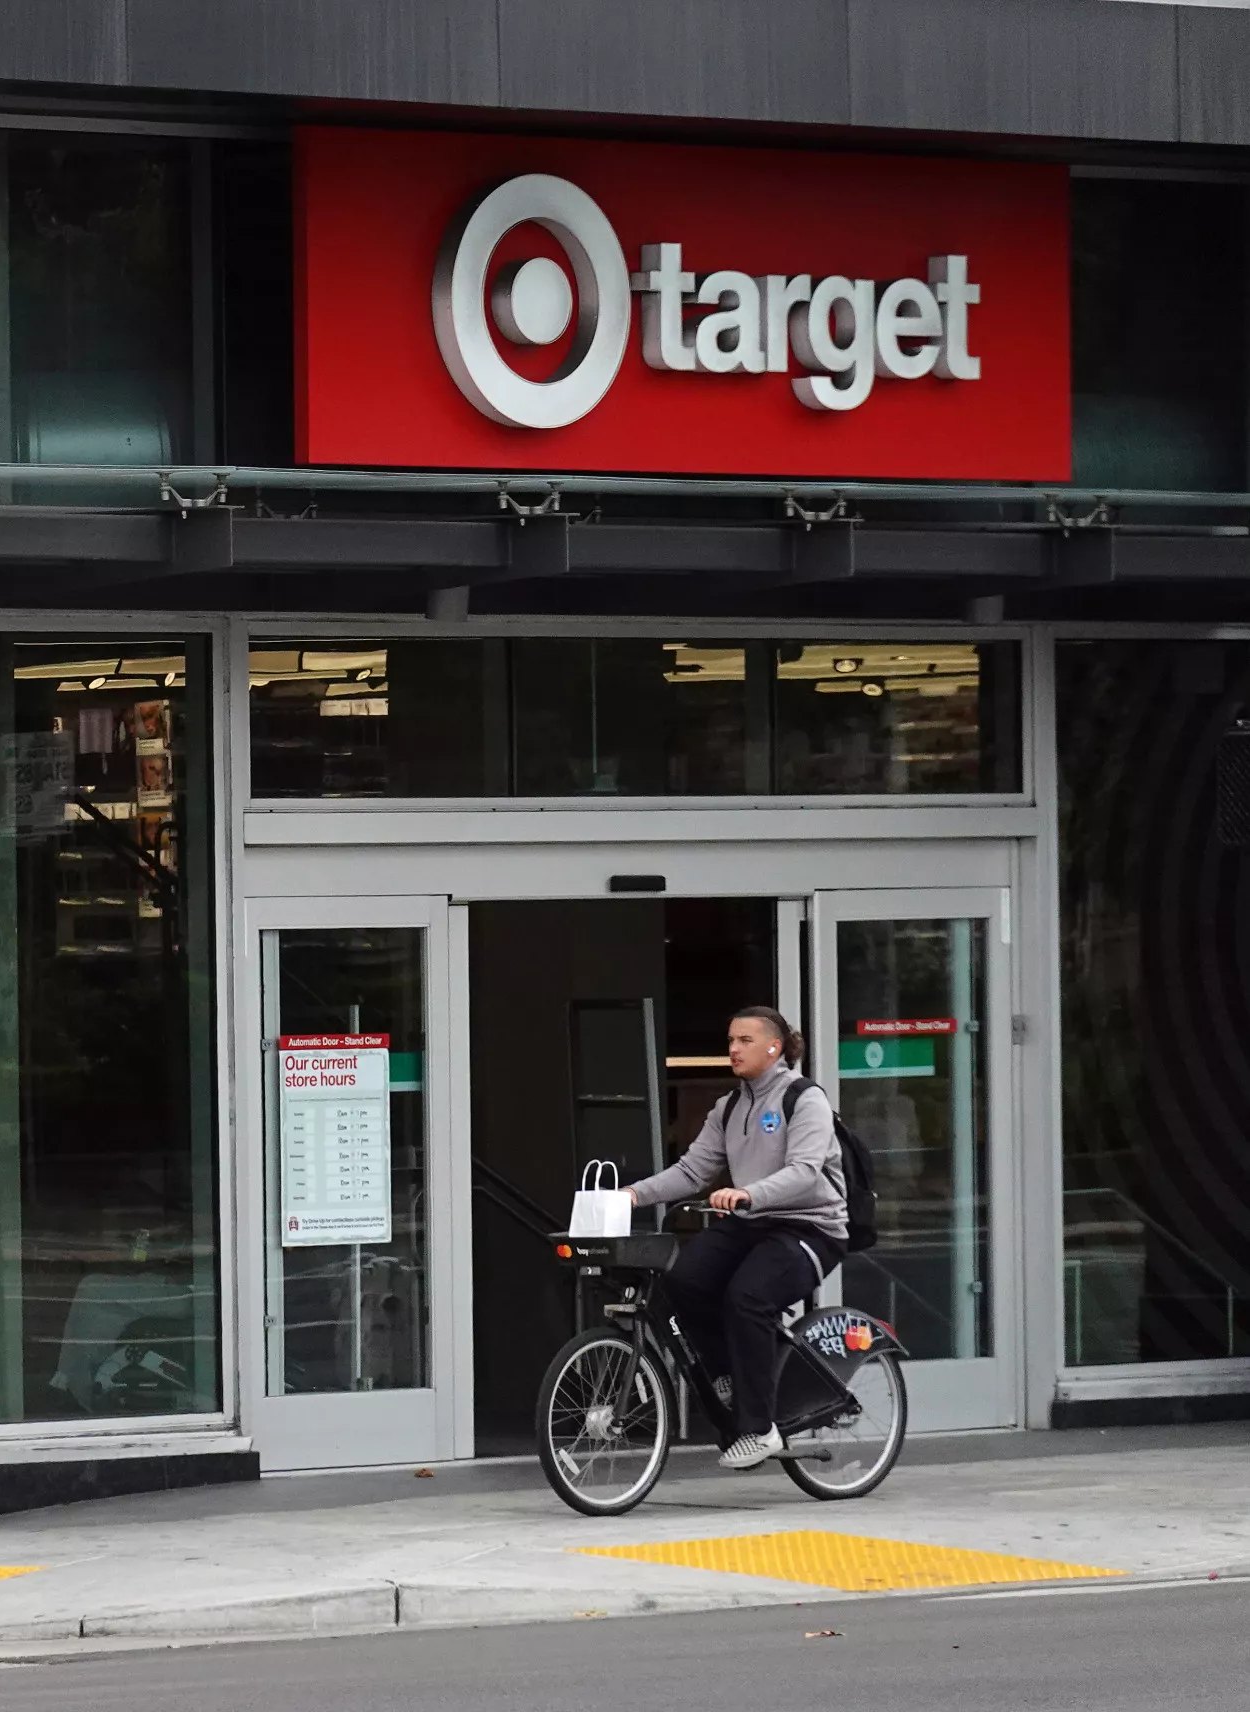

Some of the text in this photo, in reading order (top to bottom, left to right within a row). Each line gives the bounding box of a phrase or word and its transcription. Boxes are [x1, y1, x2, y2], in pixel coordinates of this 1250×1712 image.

[631, 242, 981, 411] target
[288, 1037, 321, 1047] Automatic
[322, 1036, 339, 1046] Door
[345, 1036, 364, 1046] Stand
[365, 1036, 383, 1045] Clear
[285, 1055, 358, 1070] Our current
[285, 1072, 356, 1087] store hours
